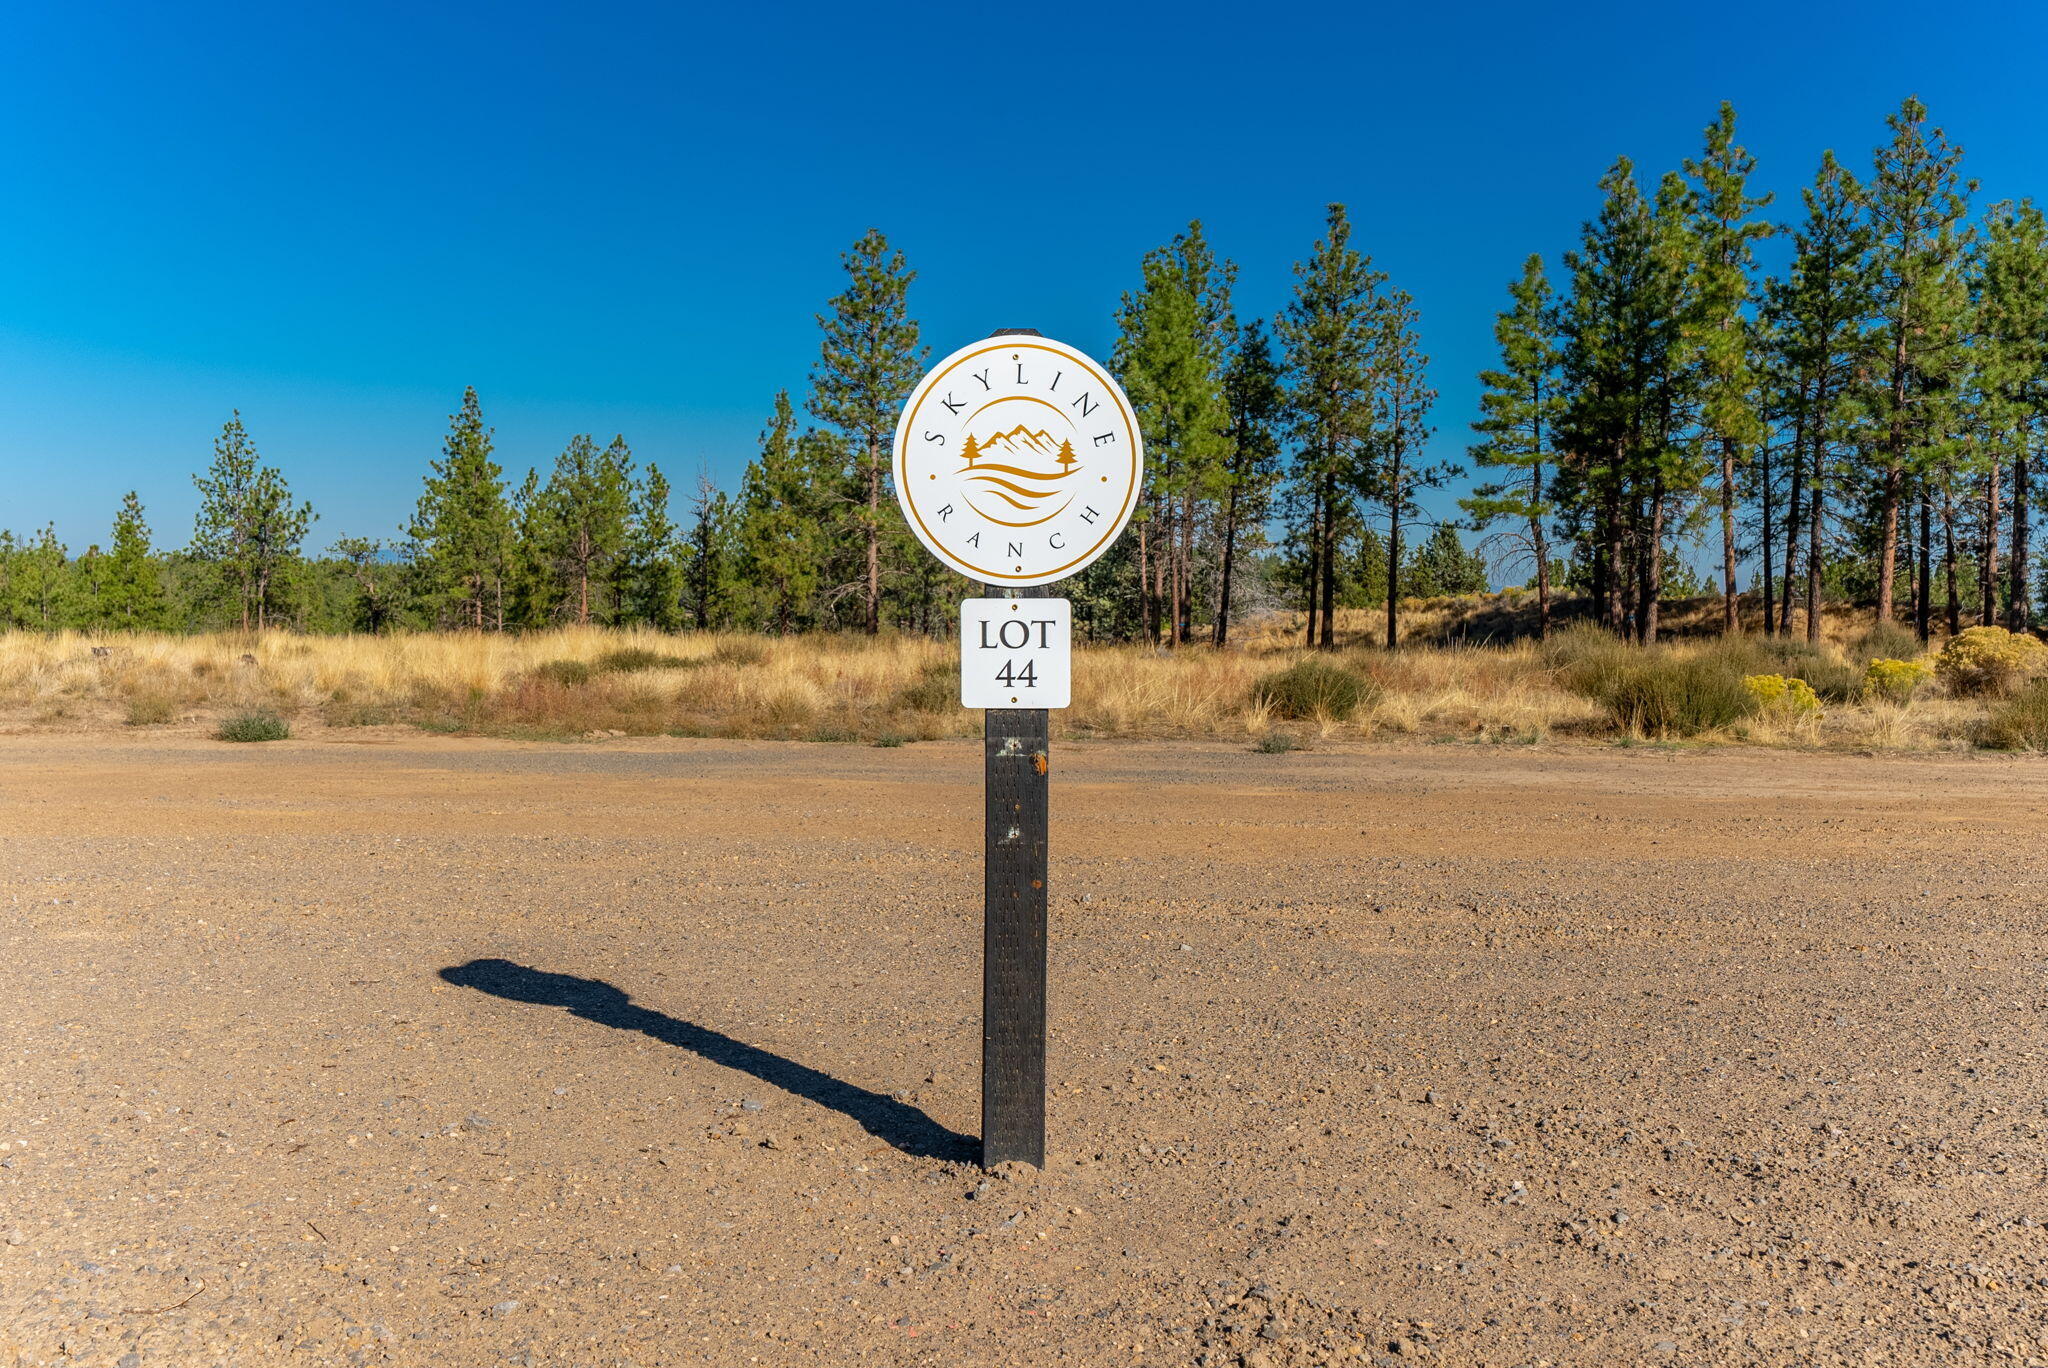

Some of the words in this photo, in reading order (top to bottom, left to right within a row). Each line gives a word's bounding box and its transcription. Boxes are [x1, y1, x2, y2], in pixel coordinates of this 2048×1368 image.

[924, 363, 1115, 448] SKYLINE
[937, 503, 1100, 558] RANCH
[978, 619, 1056, 650] LOT
[995, 659, 1038, 688] 44
